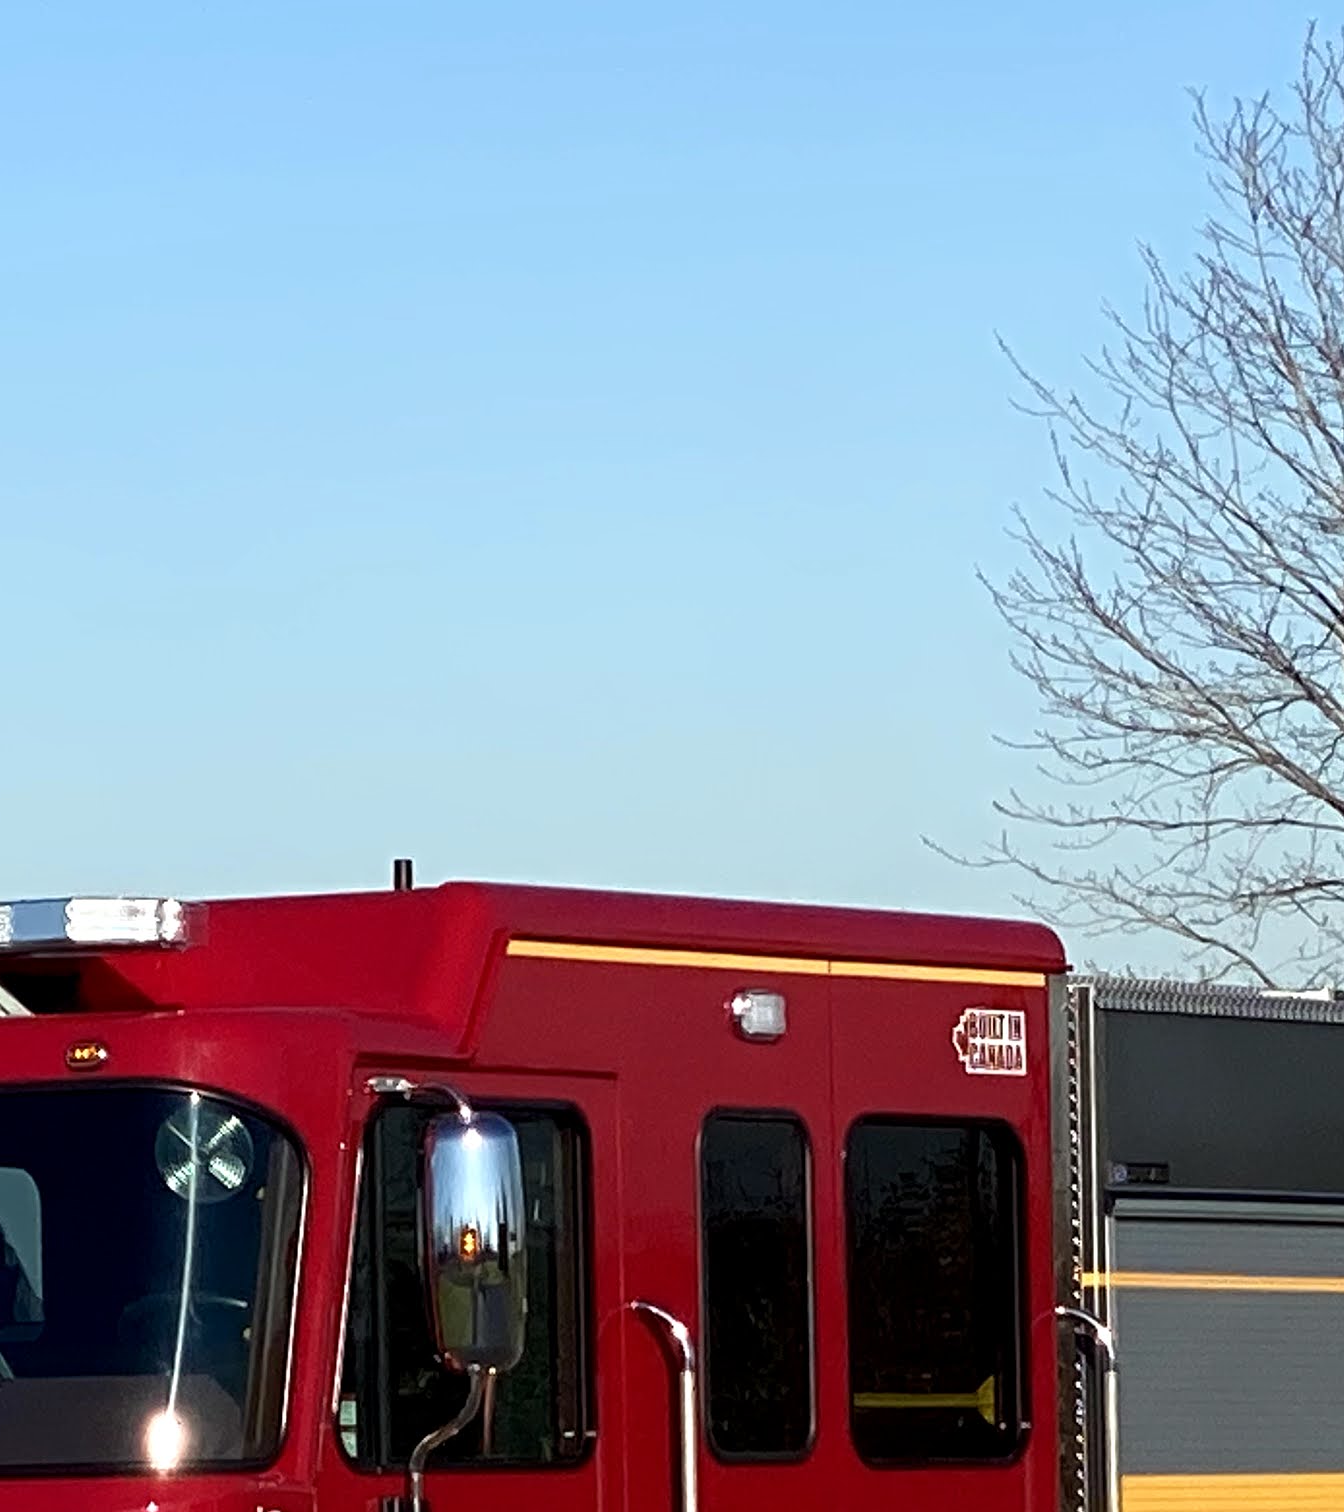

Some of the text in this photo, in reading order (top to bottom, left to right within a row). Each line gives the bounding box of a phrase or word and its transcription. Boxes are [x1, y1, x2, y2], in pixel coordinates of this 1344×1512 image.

[967, 1012, 1021, 1041] BUILT IN
[968, 1043, 1023, 1070] CANADA
